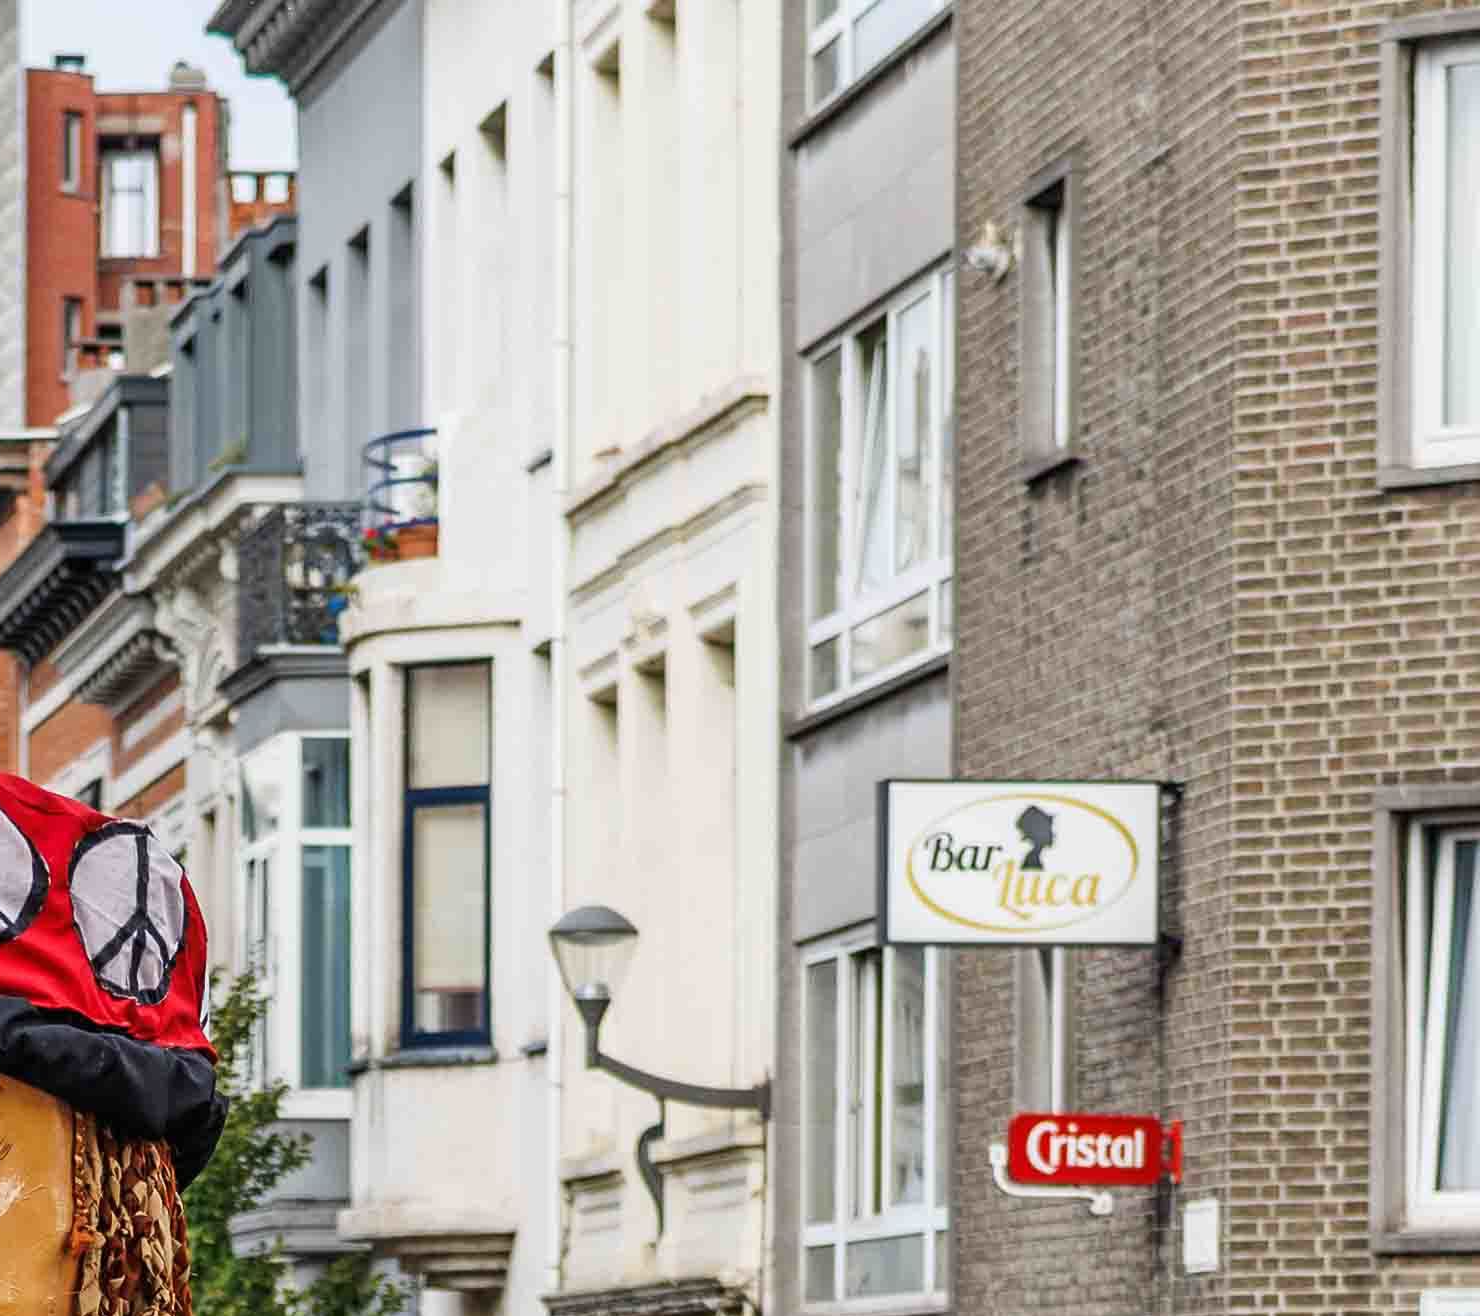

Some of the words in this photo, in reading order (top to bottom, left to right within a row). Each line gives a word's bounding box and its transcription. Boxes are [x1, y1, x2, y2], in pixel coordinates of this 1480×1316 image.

[924, 831, 1003, 872] Bar
[993, 859, 1101, 920] Luca
[1026, 1120, 1146, 1175] Cristal
